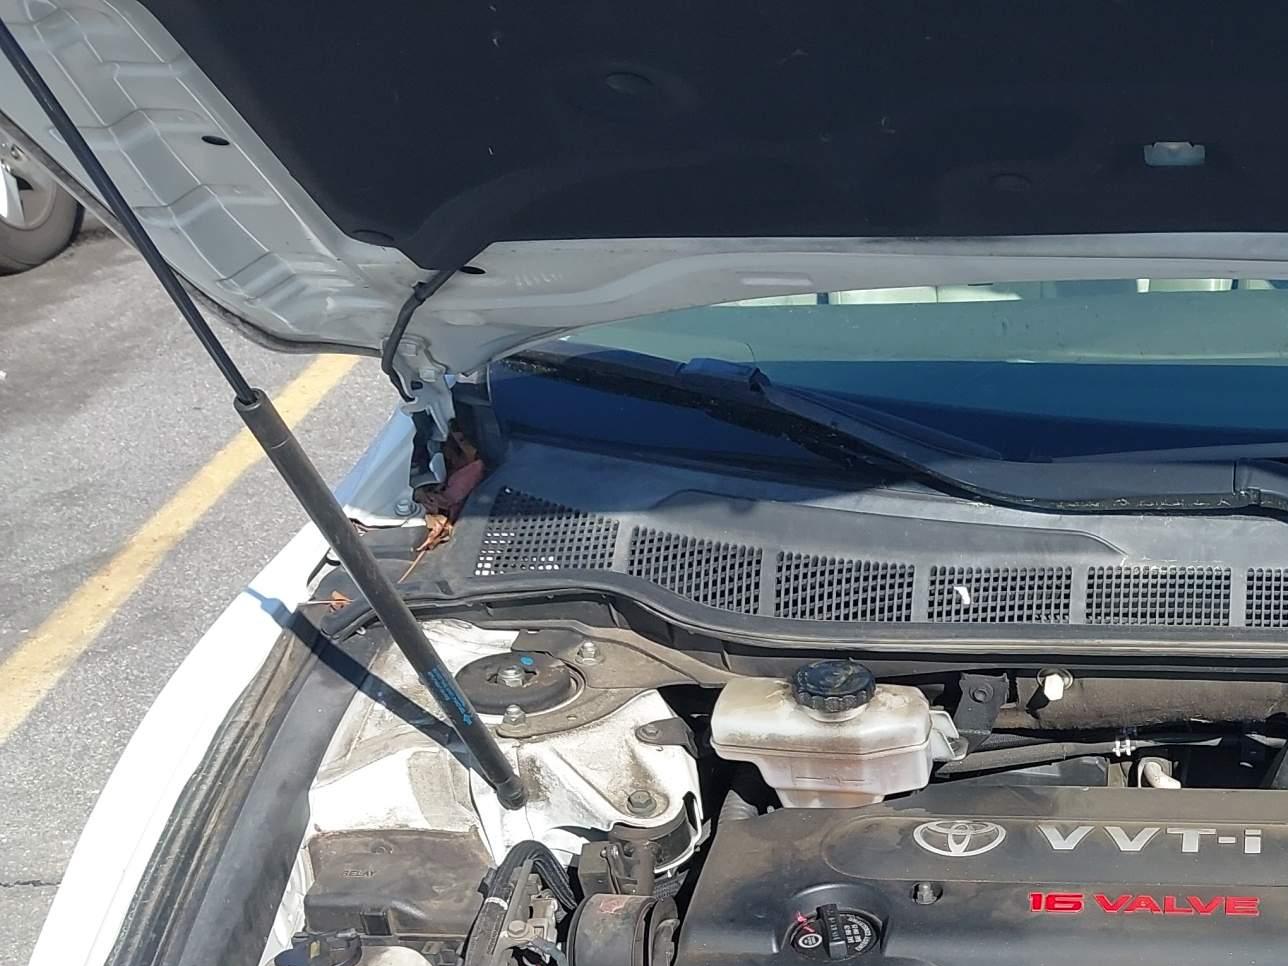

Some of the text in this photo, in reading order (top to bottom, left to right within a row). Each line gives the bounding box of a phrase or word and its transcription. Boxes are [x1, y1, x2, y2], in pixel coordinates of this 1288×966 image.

[1037, 825, 1262, 854] VVT-i
[1029, 892, 1261, 917] 16 VALVE
